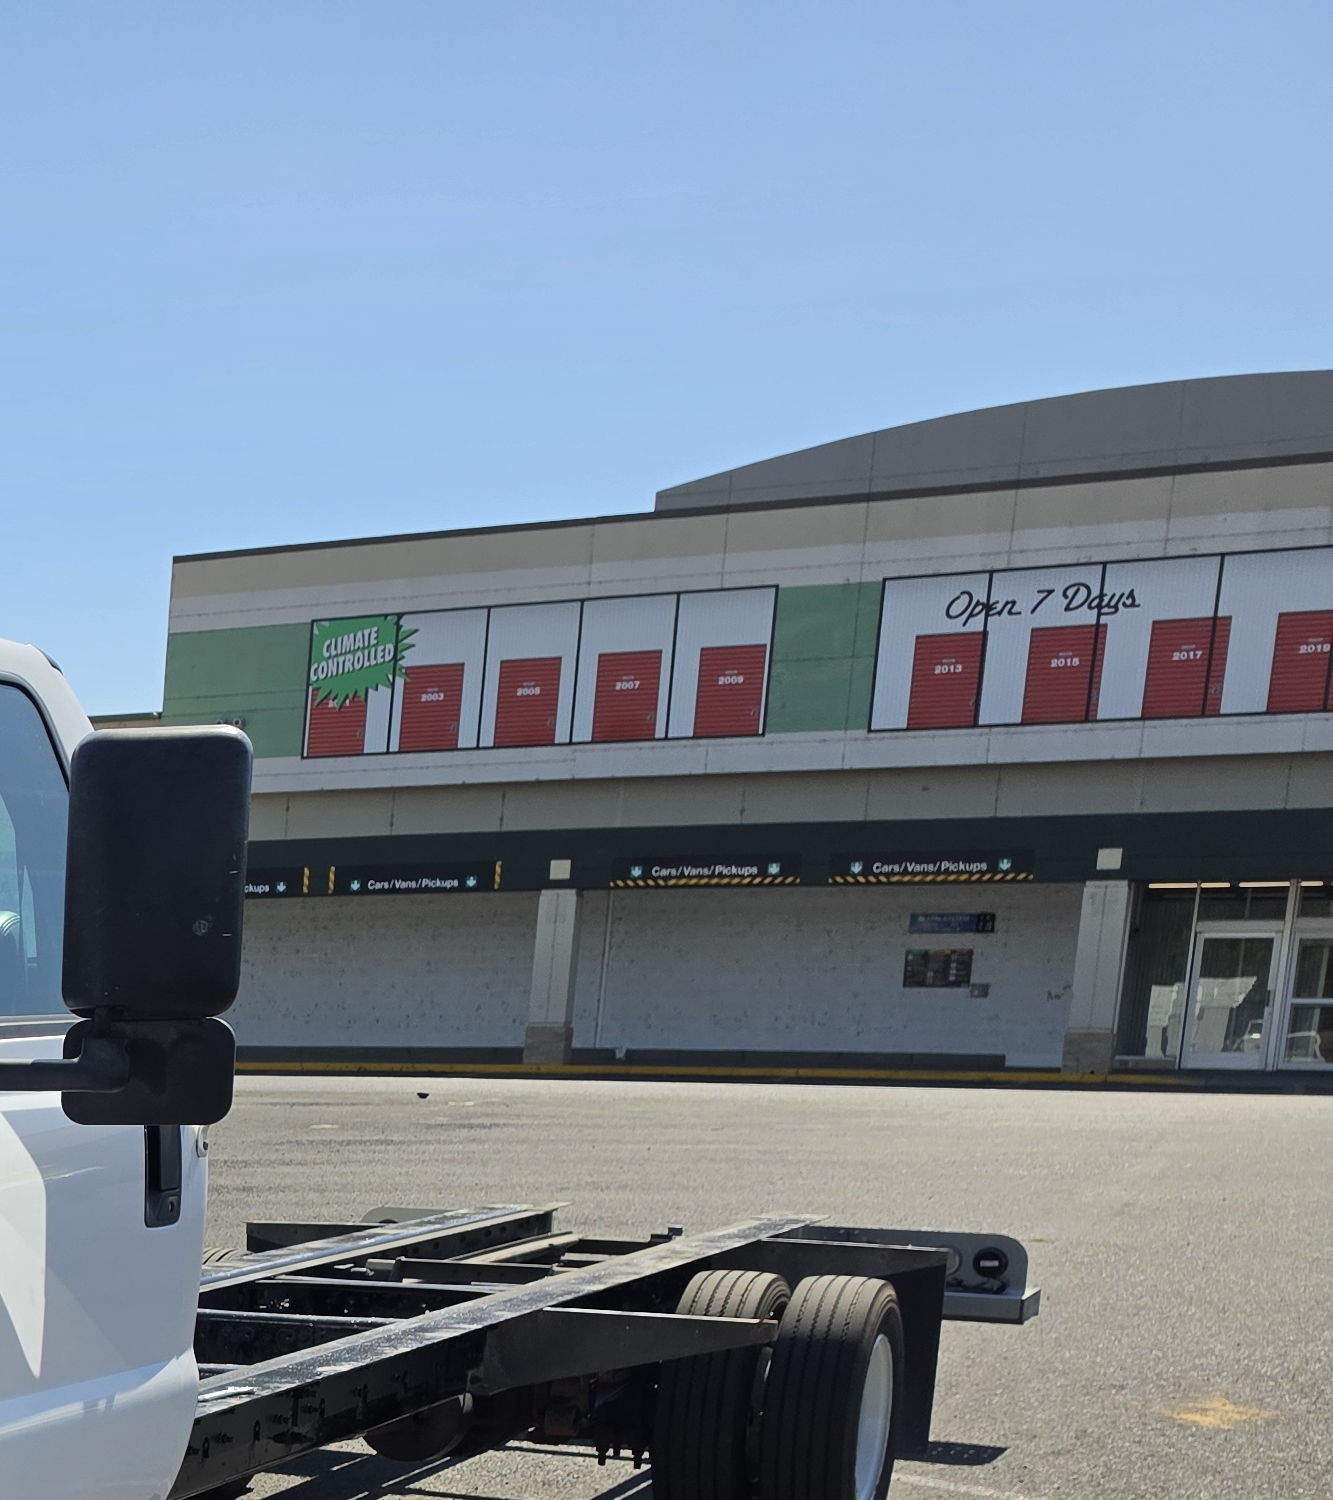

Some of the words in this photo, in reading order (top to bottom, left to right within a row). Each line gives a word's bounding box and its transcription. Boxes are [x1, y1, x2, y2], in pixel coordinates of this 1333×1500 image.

[945, 590, 1022, 627] Open
[1030, 589, 1055, 614] 7
[1062, 582, 1141, 616] Days
[322, 626, 379, 659] CLIMATE
[310, 643, 395, 681] CONTROLLED
[420, 692, 445, 702] 2003
[652, 864, 758, 877] Cars/Vans/Pickups
[873, 860, 988, 874] Cars/Vans/Pickups
[368, 878, 459, 891] Cars/Vans/Pickups
